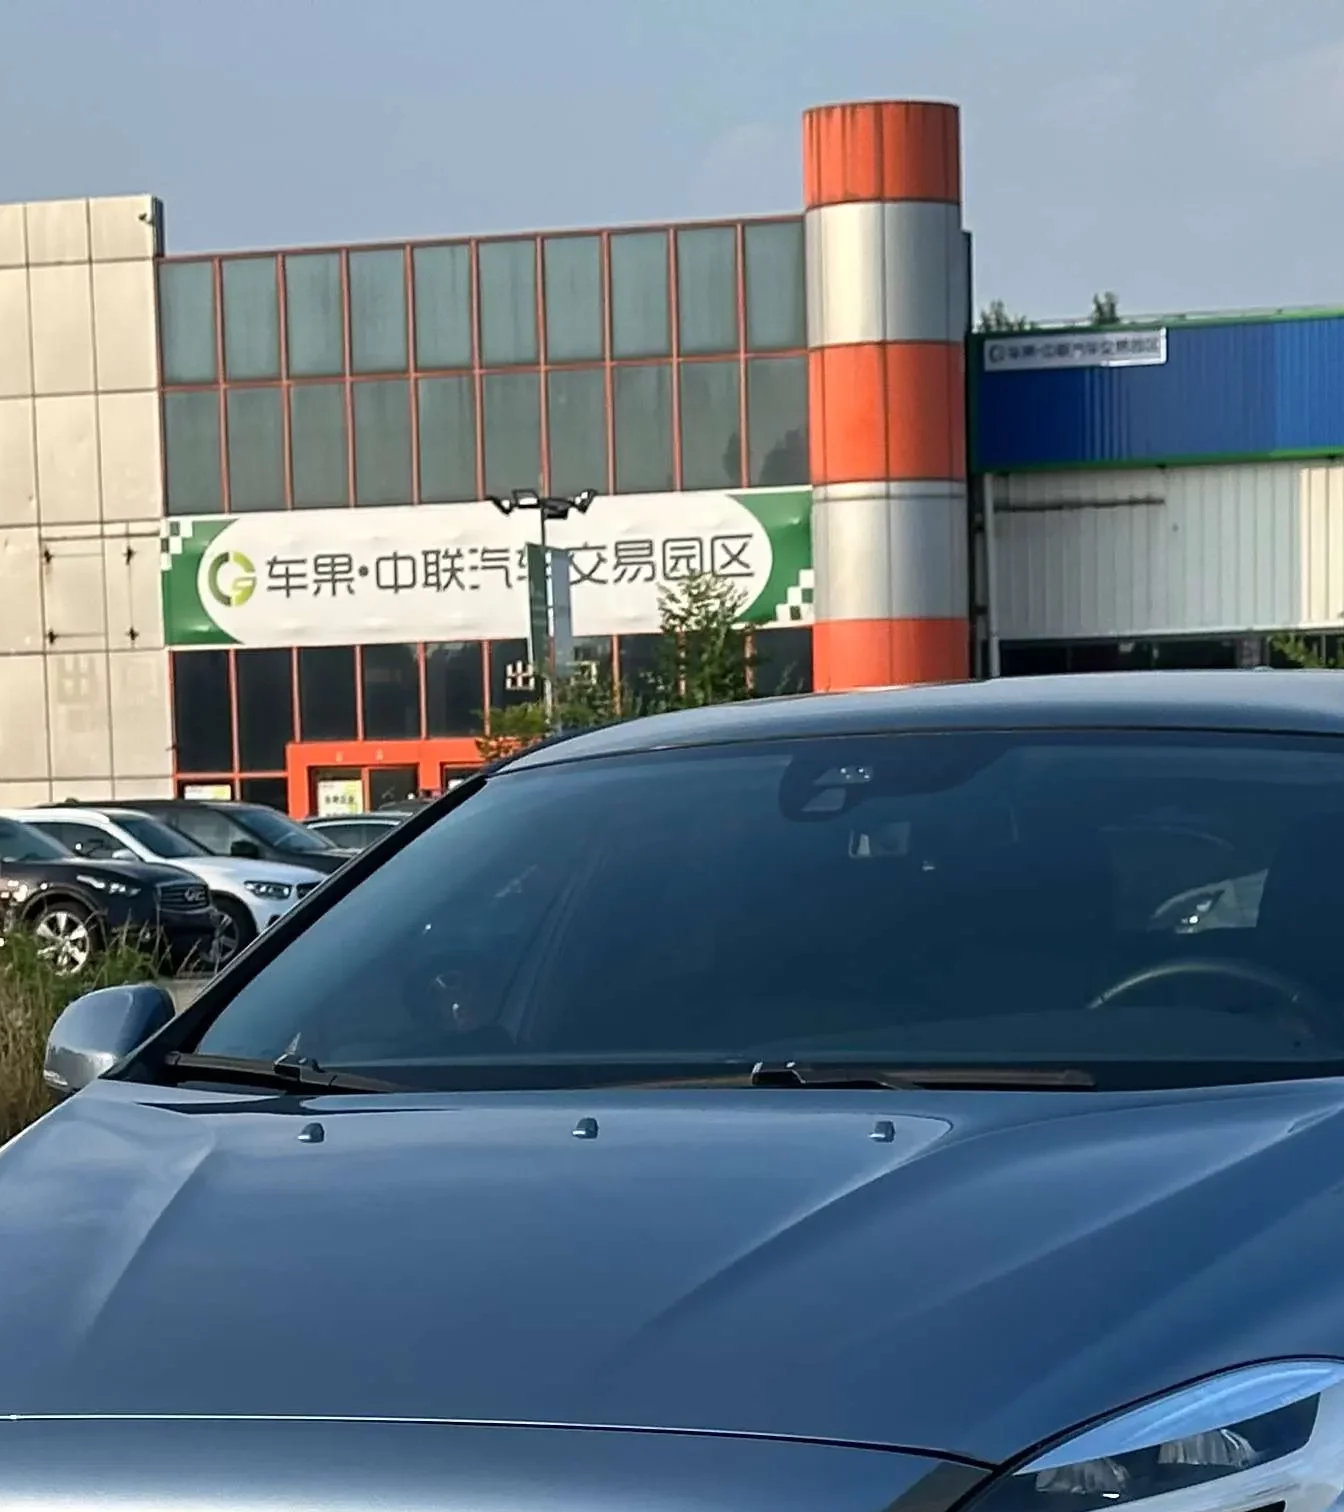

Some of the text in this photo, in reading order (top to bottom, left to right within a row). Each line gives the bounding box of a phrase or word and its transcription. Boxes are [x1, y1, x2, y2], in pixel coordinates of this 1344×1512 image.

[265, 533, 755, 599] 车果·中联汽交易园区
